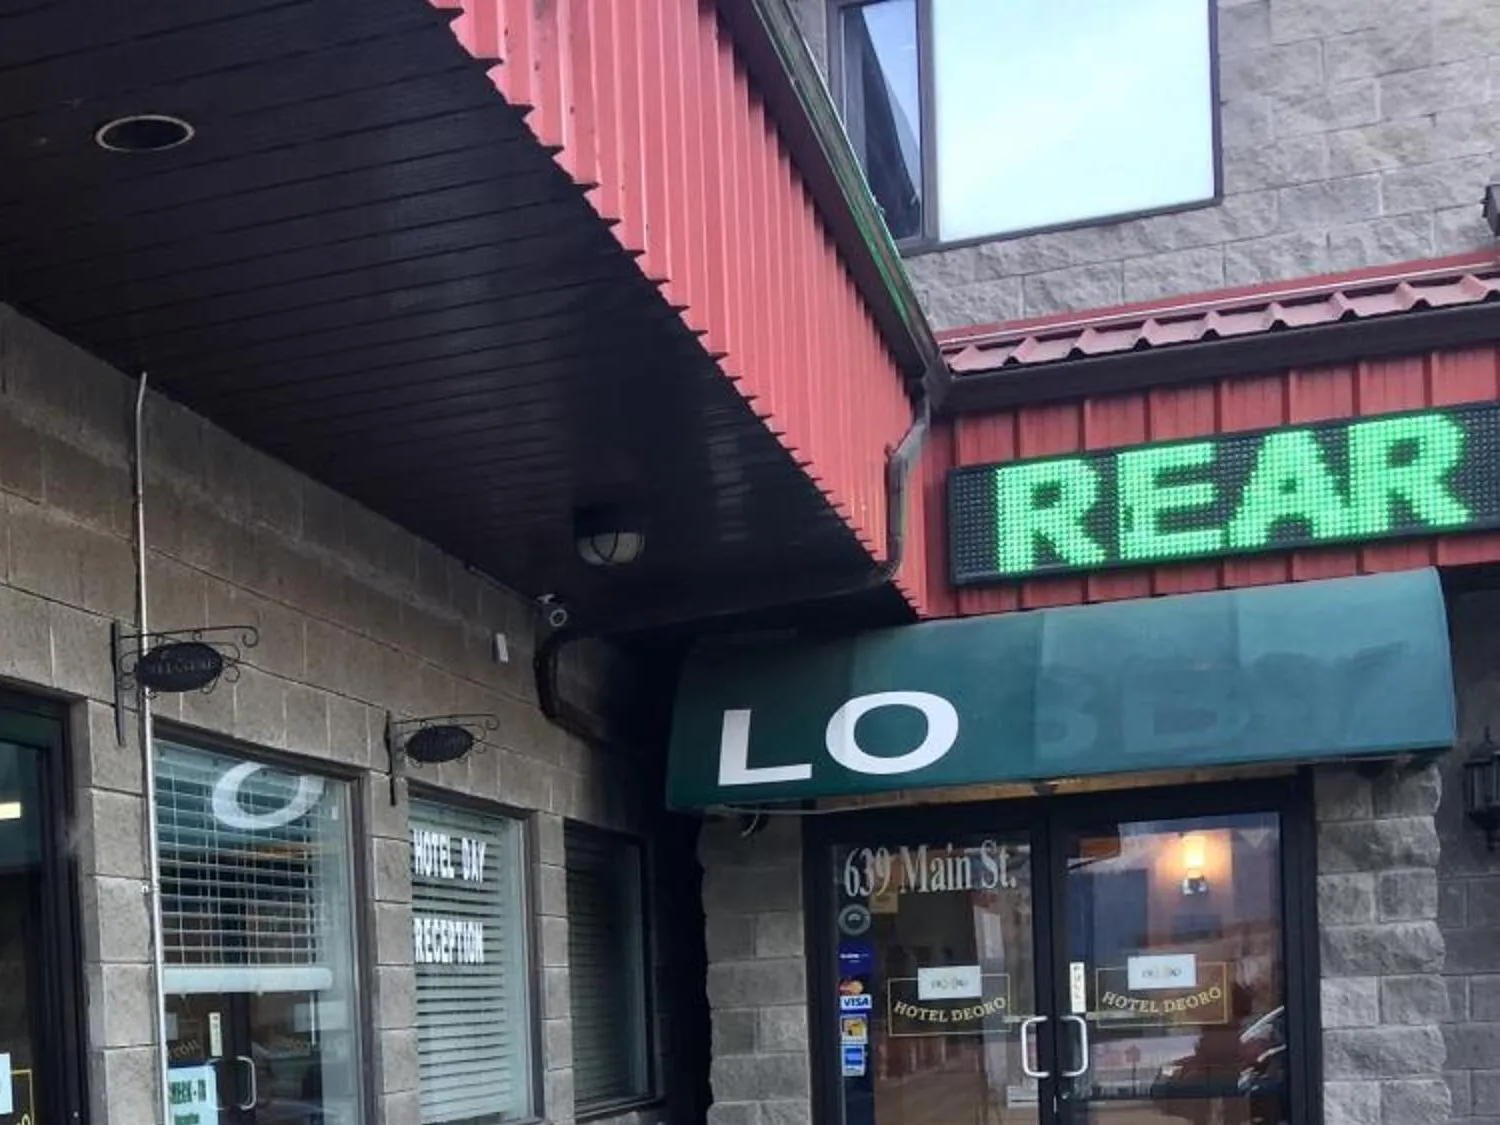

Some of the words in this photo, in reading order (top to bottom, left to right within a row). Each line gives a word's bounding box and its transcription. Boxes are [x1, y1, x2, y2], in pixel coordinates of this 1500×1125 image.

[994, 412, 1477, 577] REAR
[844, 848, 892, 897] 639
[899, 842, 973, 894] Main
[980, 839, 1017, 889] St.
[414, 918, 484, 964] RECEPTION
[843, 996, 869, 1008] VISA
[893, 1000, 949, 1023] HOTEL
[952, 997, 1006, 1021] DEORO
[1102, 991, 1160, 1013] HOTEL
[1163, 986, 1221, 1013] DEORO
